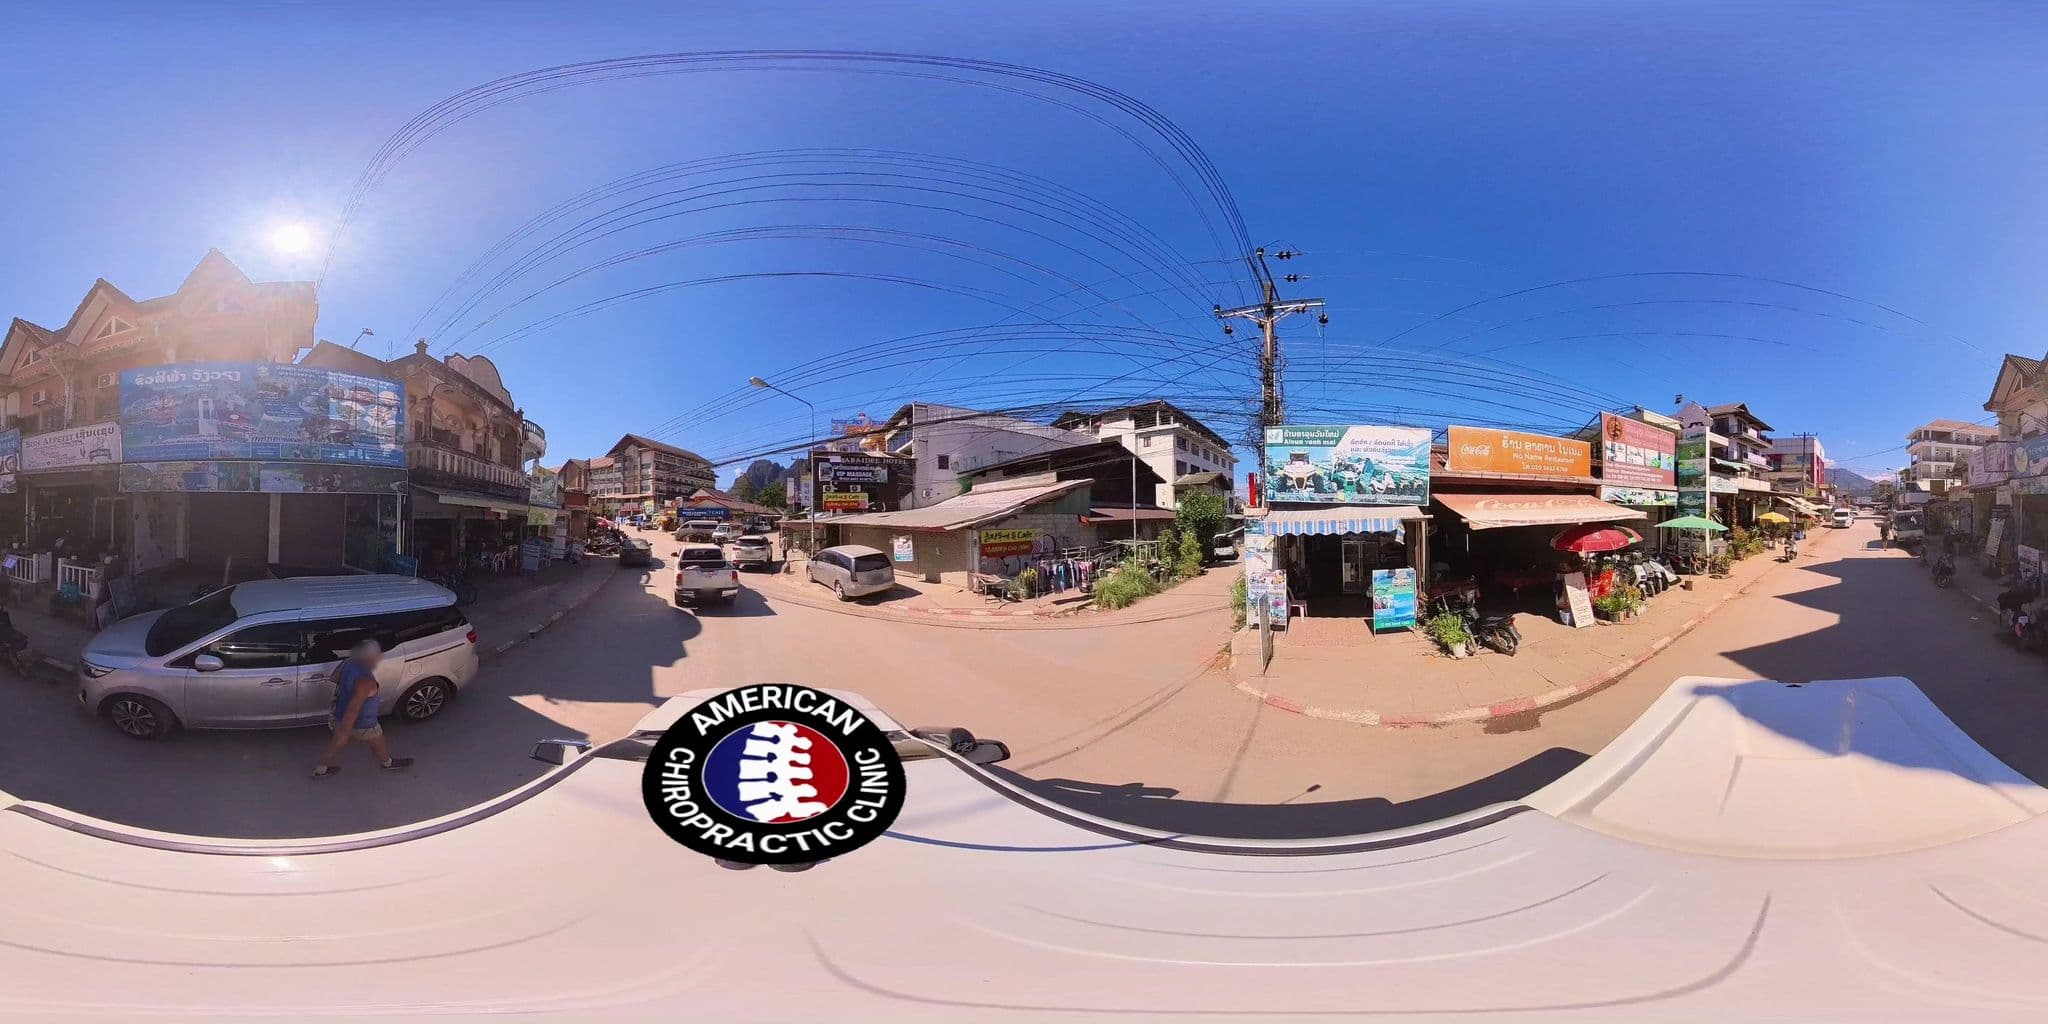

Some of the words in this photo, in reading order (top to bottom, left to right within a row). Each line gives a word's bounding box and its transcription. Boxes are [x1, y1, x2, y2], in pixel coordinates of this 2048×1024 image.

[1460, 443, 1490, 456] Coca-Cola
[1512, 452, 1523, 460] No
[1524, 453, 1543, 461] Name
[1544, 455, 1575, 464] Restaurant
